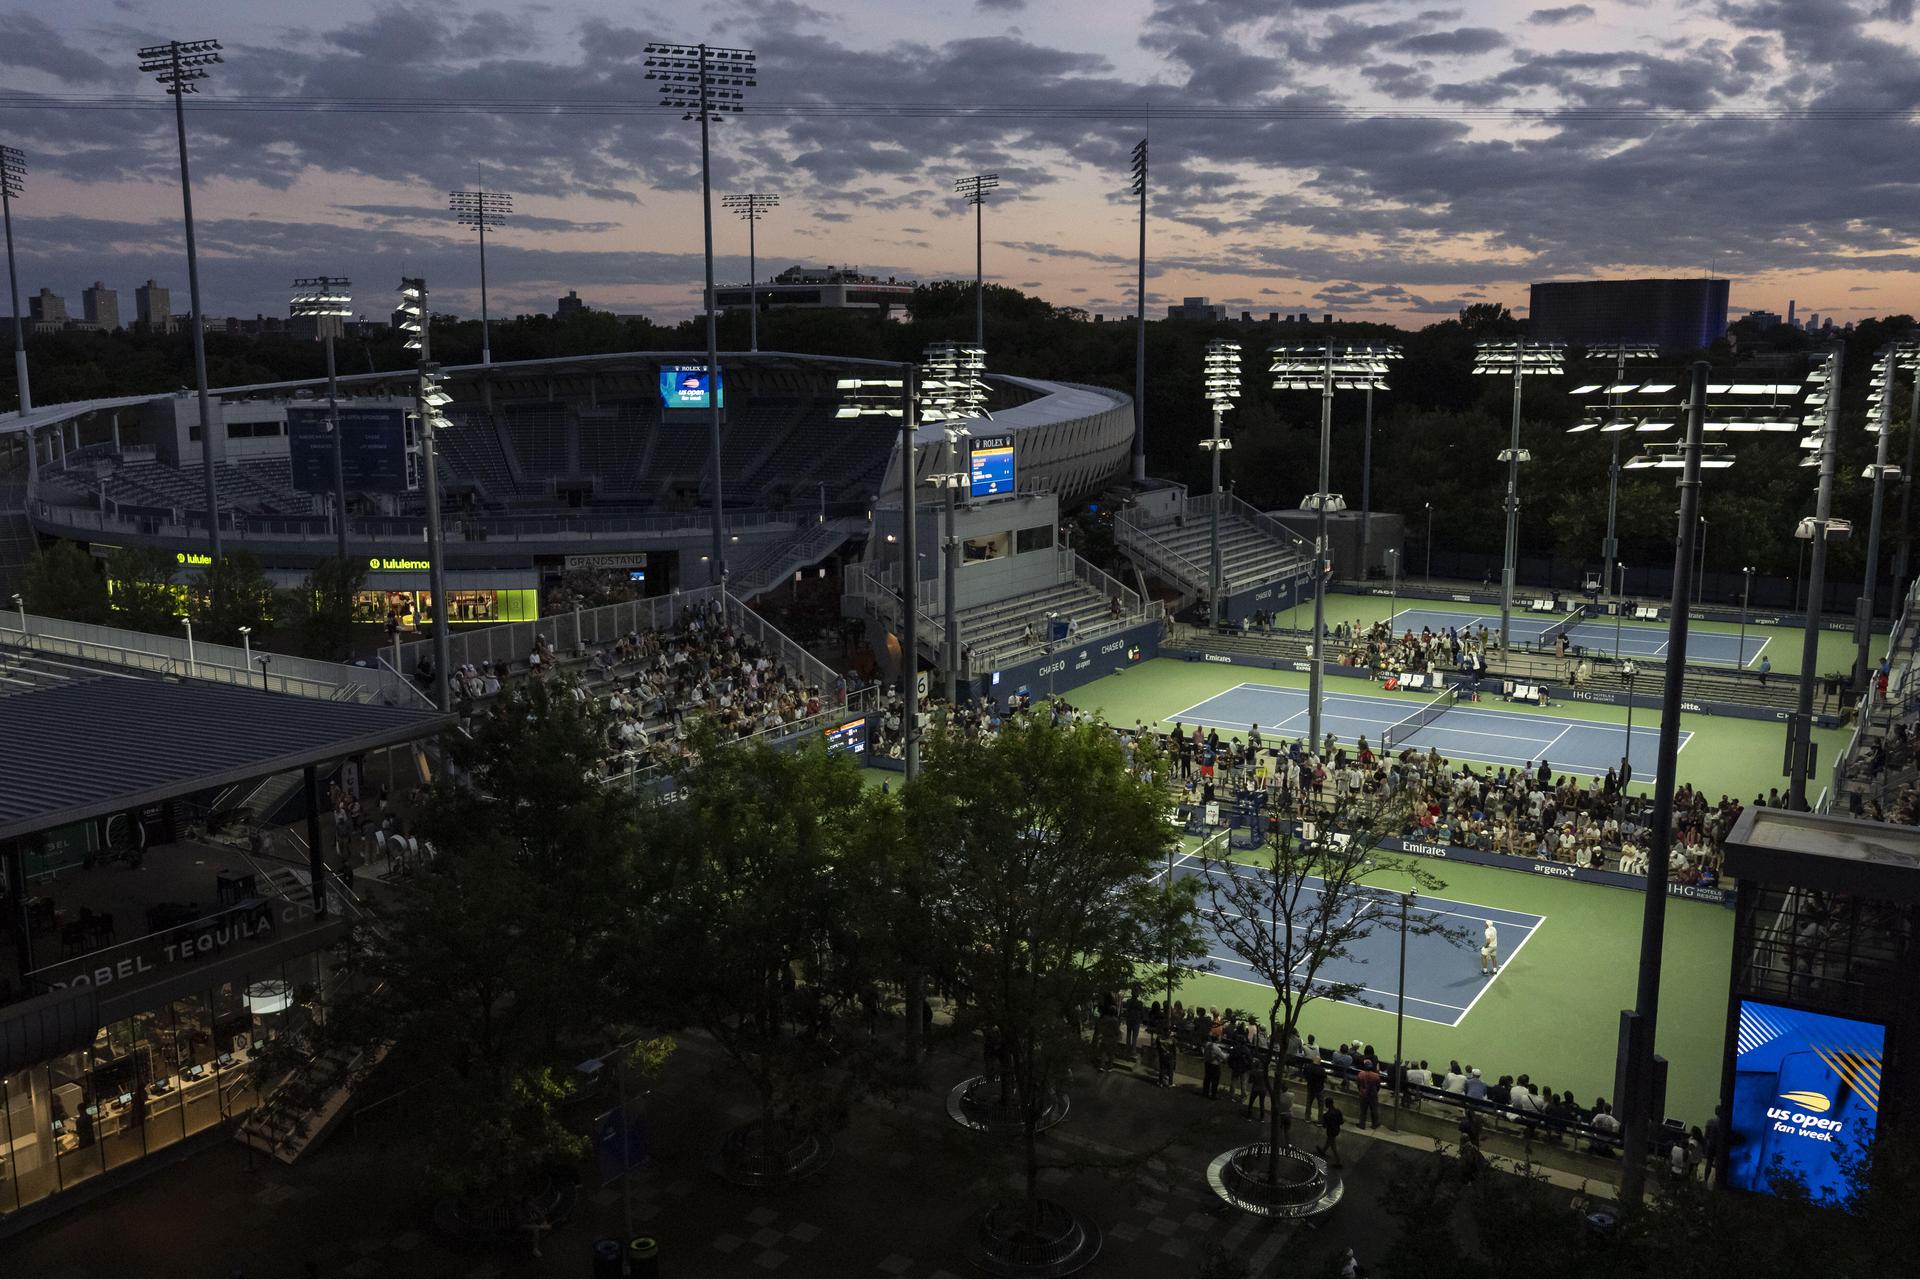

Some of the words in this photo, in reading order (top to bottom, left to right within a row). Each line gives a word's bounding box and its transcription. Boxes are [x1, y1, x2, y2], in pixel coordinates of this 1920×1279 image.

[983, 438, 1004, 448] ROLEX
[569, 554, 643, 567] GRANDSTAND
[1102, 643, 1119, 655] CHASE
[1205, 653, 1232, 663] Emirates
[1039, 661, 1060, 677] CHASE
[917, 677, 926, 694] 6
[1573, 690, 1591, 700] IHG
[1402, 841, 1447, 857] Emirates
[1534, 863, 1568, 876] argenx
[1668, 883, 1695, 896] IHG
[164, 914, 272, 963] TEQUILA
[1766, 1107, 1791, 1121] us
[1791, 1113, 1843, 1133] open
[1773, 1121, 1796, 1134] fan
[1798, 1128, 1834, 1143] week
